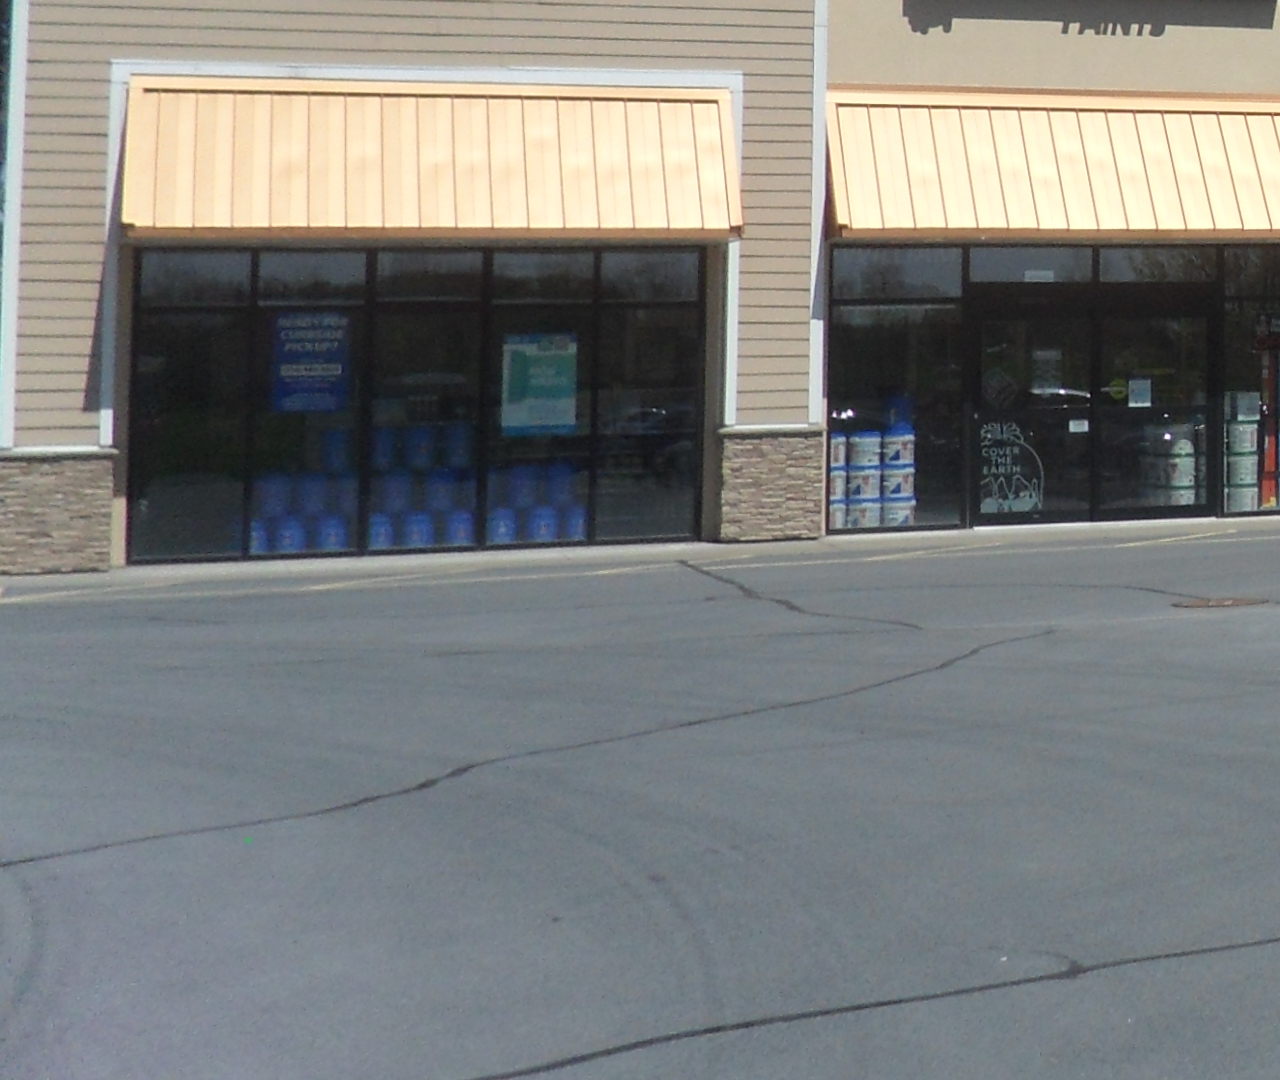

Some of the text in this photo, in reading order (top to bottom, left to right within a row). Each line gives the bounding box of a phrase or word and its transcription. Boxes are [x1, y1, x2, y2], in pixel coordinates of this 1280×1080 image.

[981, 447, 1020, 456] COVER
[990, 456, 1012, 465] THE
[983, 465, 1021, 475] EARTH
